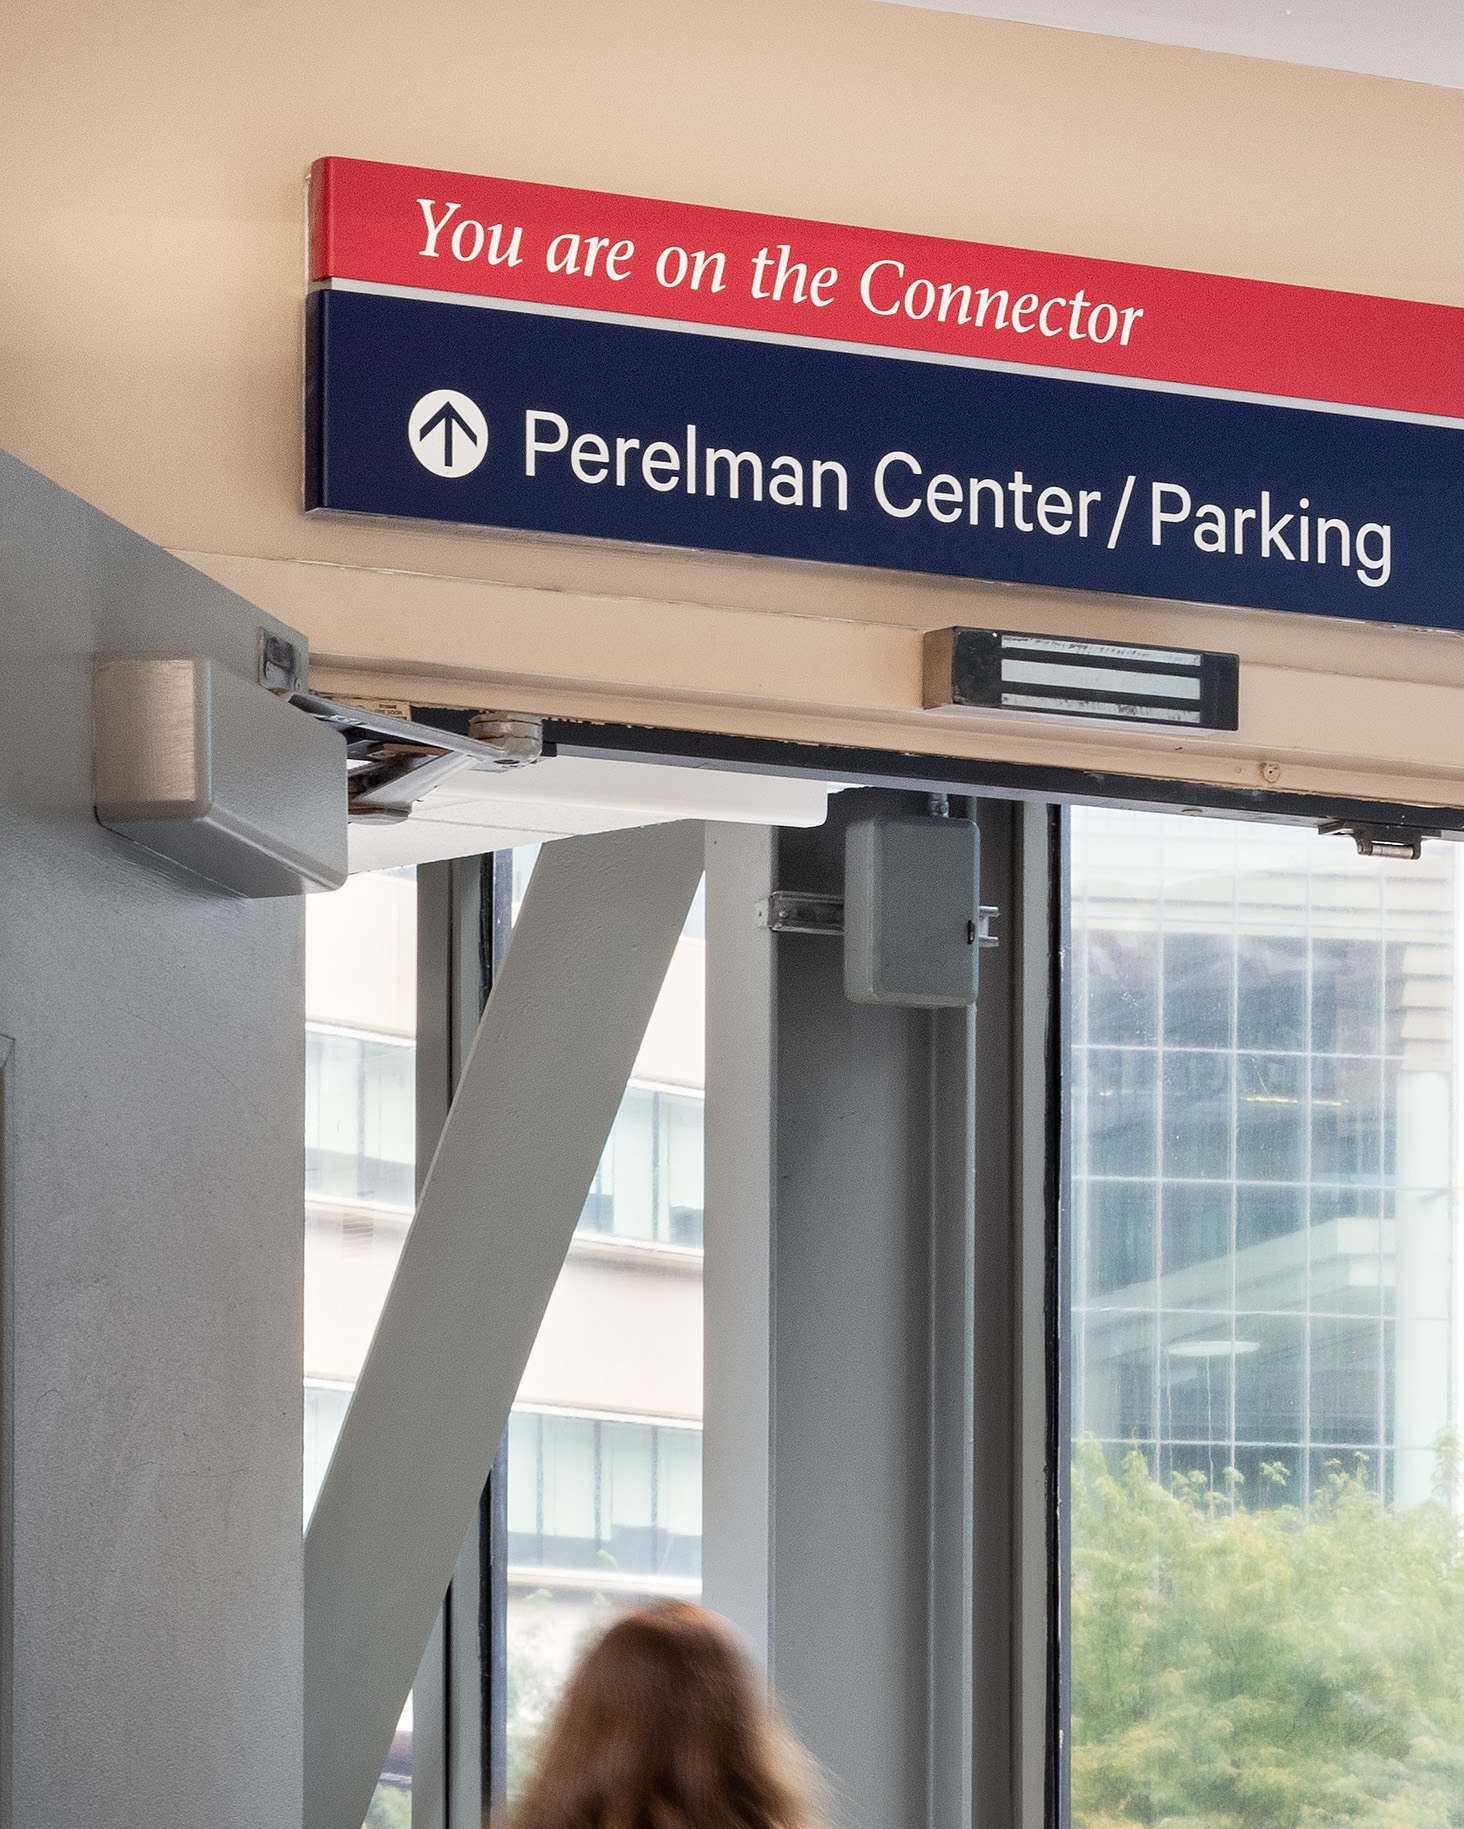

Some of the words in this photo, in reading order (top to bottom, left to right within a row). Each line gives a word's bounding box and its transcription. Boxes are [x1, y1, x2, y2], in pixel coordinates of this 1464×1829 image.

[416, 198, 523, 268] You
[546, 233, 635, 281] are
[655, 246, 727, 294] on
[751, 244, 839, 308] the
[860, 259, 1144, 346] Connector
[525, 409, 848, 511] Perelman
